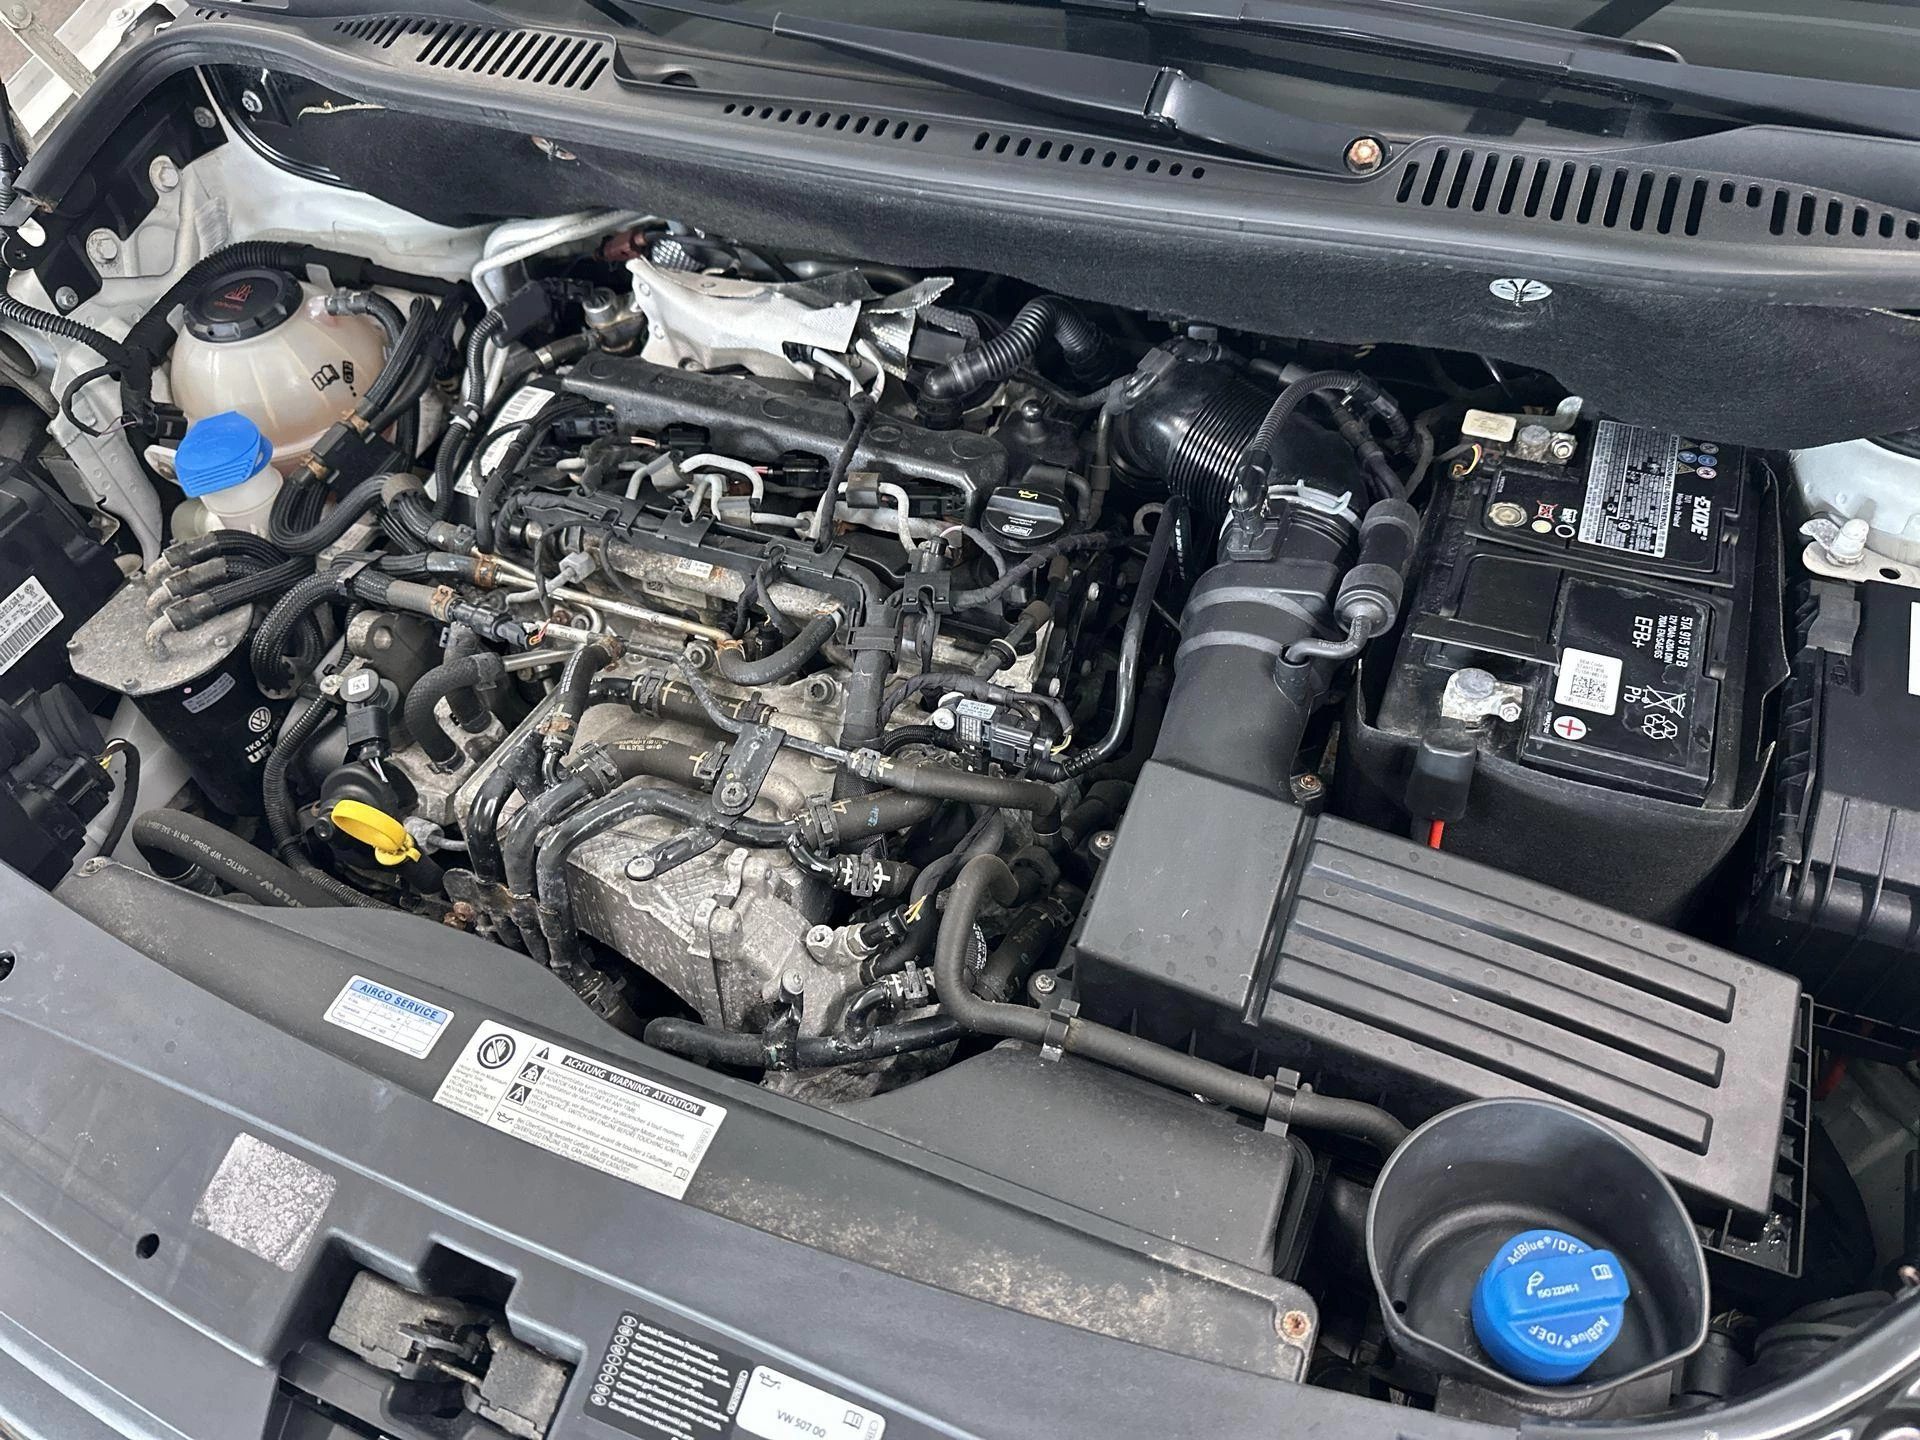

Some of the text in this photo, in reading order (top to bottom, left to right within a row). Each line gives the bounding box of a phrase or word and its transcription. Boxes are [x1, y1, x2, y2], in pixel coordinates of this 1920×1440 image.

[1668, 614, 1677, 624] 12V
[1679, 615, 1693, 630] 5TA
[1631, 615, 1653, 648] EFB+
[1677, 630, 1691, 645] 915
[1663, 652, 1672, 663] DIN
[1676, 646, 1689, 660] 105
[1623, 684, 1642, 703] Pb
[191, 837, 212, 854] 35bar
[209, 848, 222, 861] WP
[224, 856, 249, 876] ARTIC
[359, 983, 393, 1001] AIRCO
[392, 996, 438, 1019] SERVICE
[564, 1057, 699, 1113] ACHTUNG WARNING ATTENTION
[775, 1409, 826, 1438] VW 507 00
